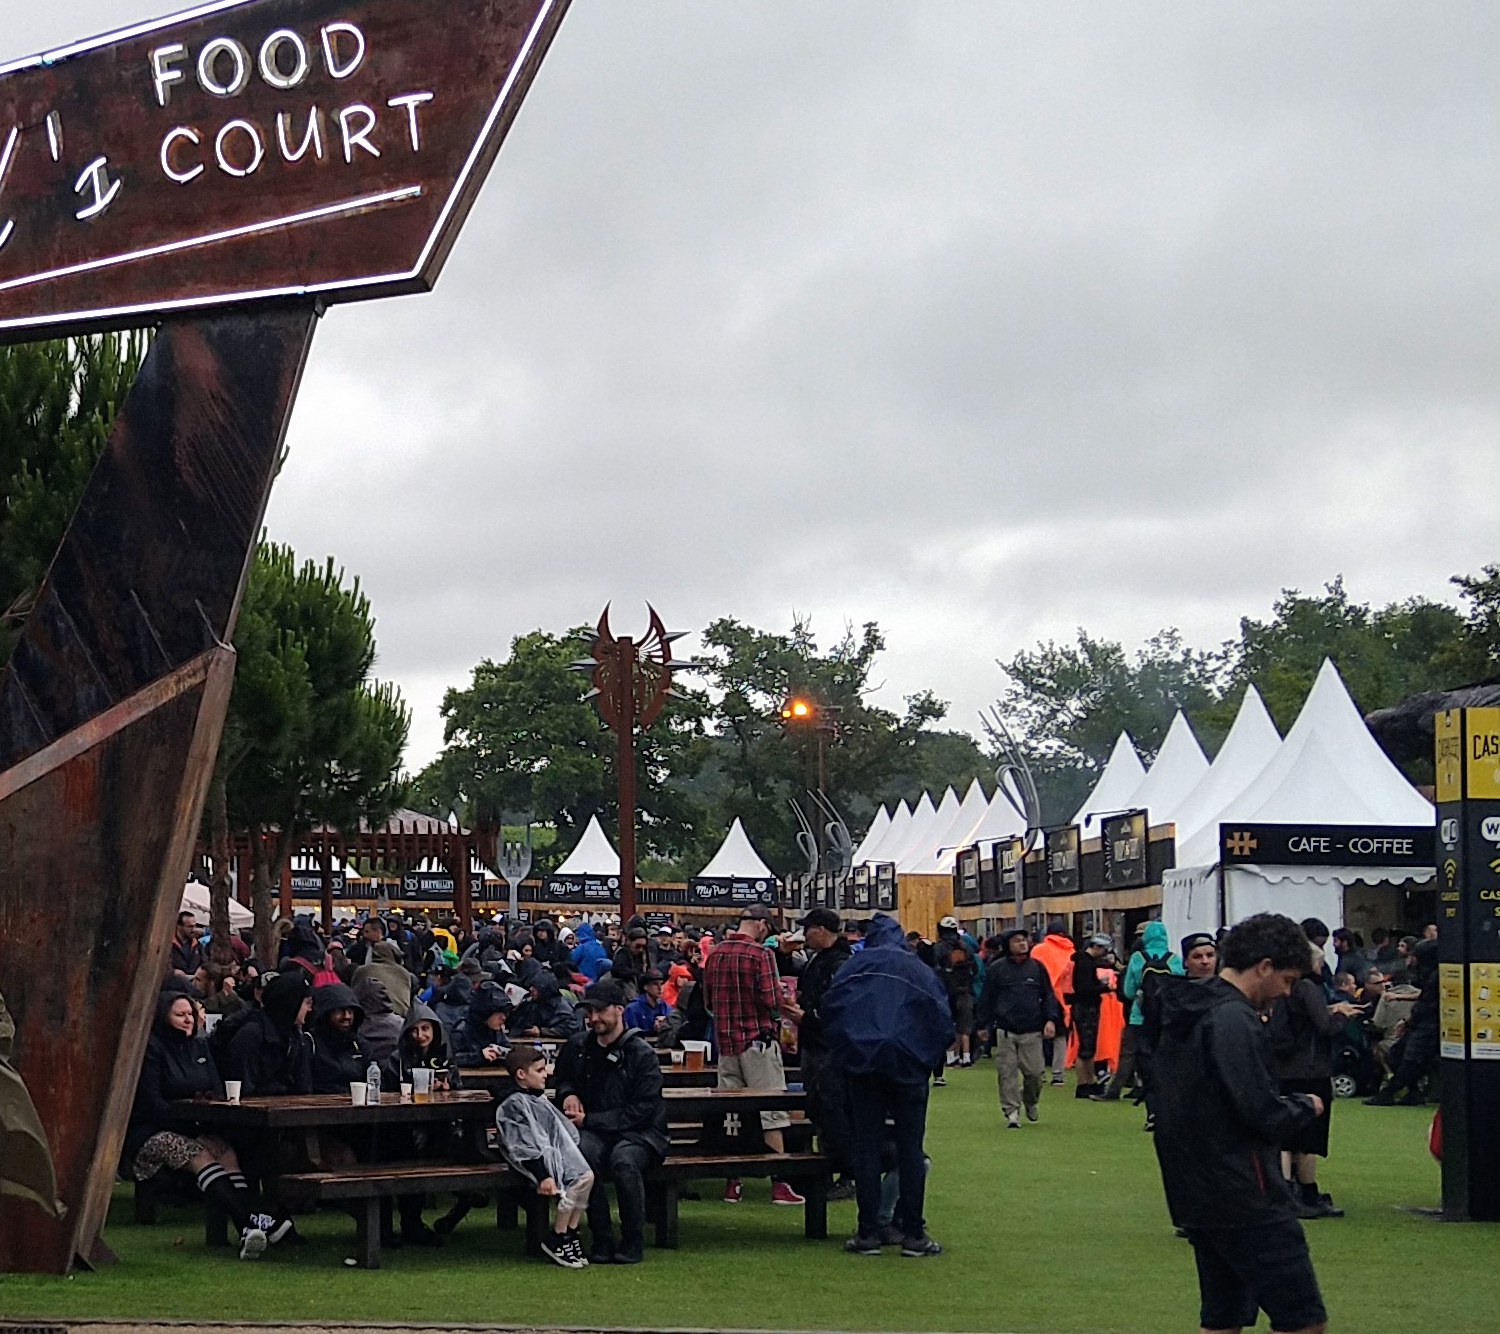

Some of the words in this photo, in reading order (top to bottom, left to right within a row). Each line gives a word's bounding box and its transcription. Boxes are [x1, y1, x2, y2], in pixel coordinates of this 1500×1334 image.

[152, 22, 367, 108] FOOD
[160, 92, 436, 181] COURT
[1288, 837, 1331, 853] CAFE
[1348, 838, 1414, 855] COFFEE
